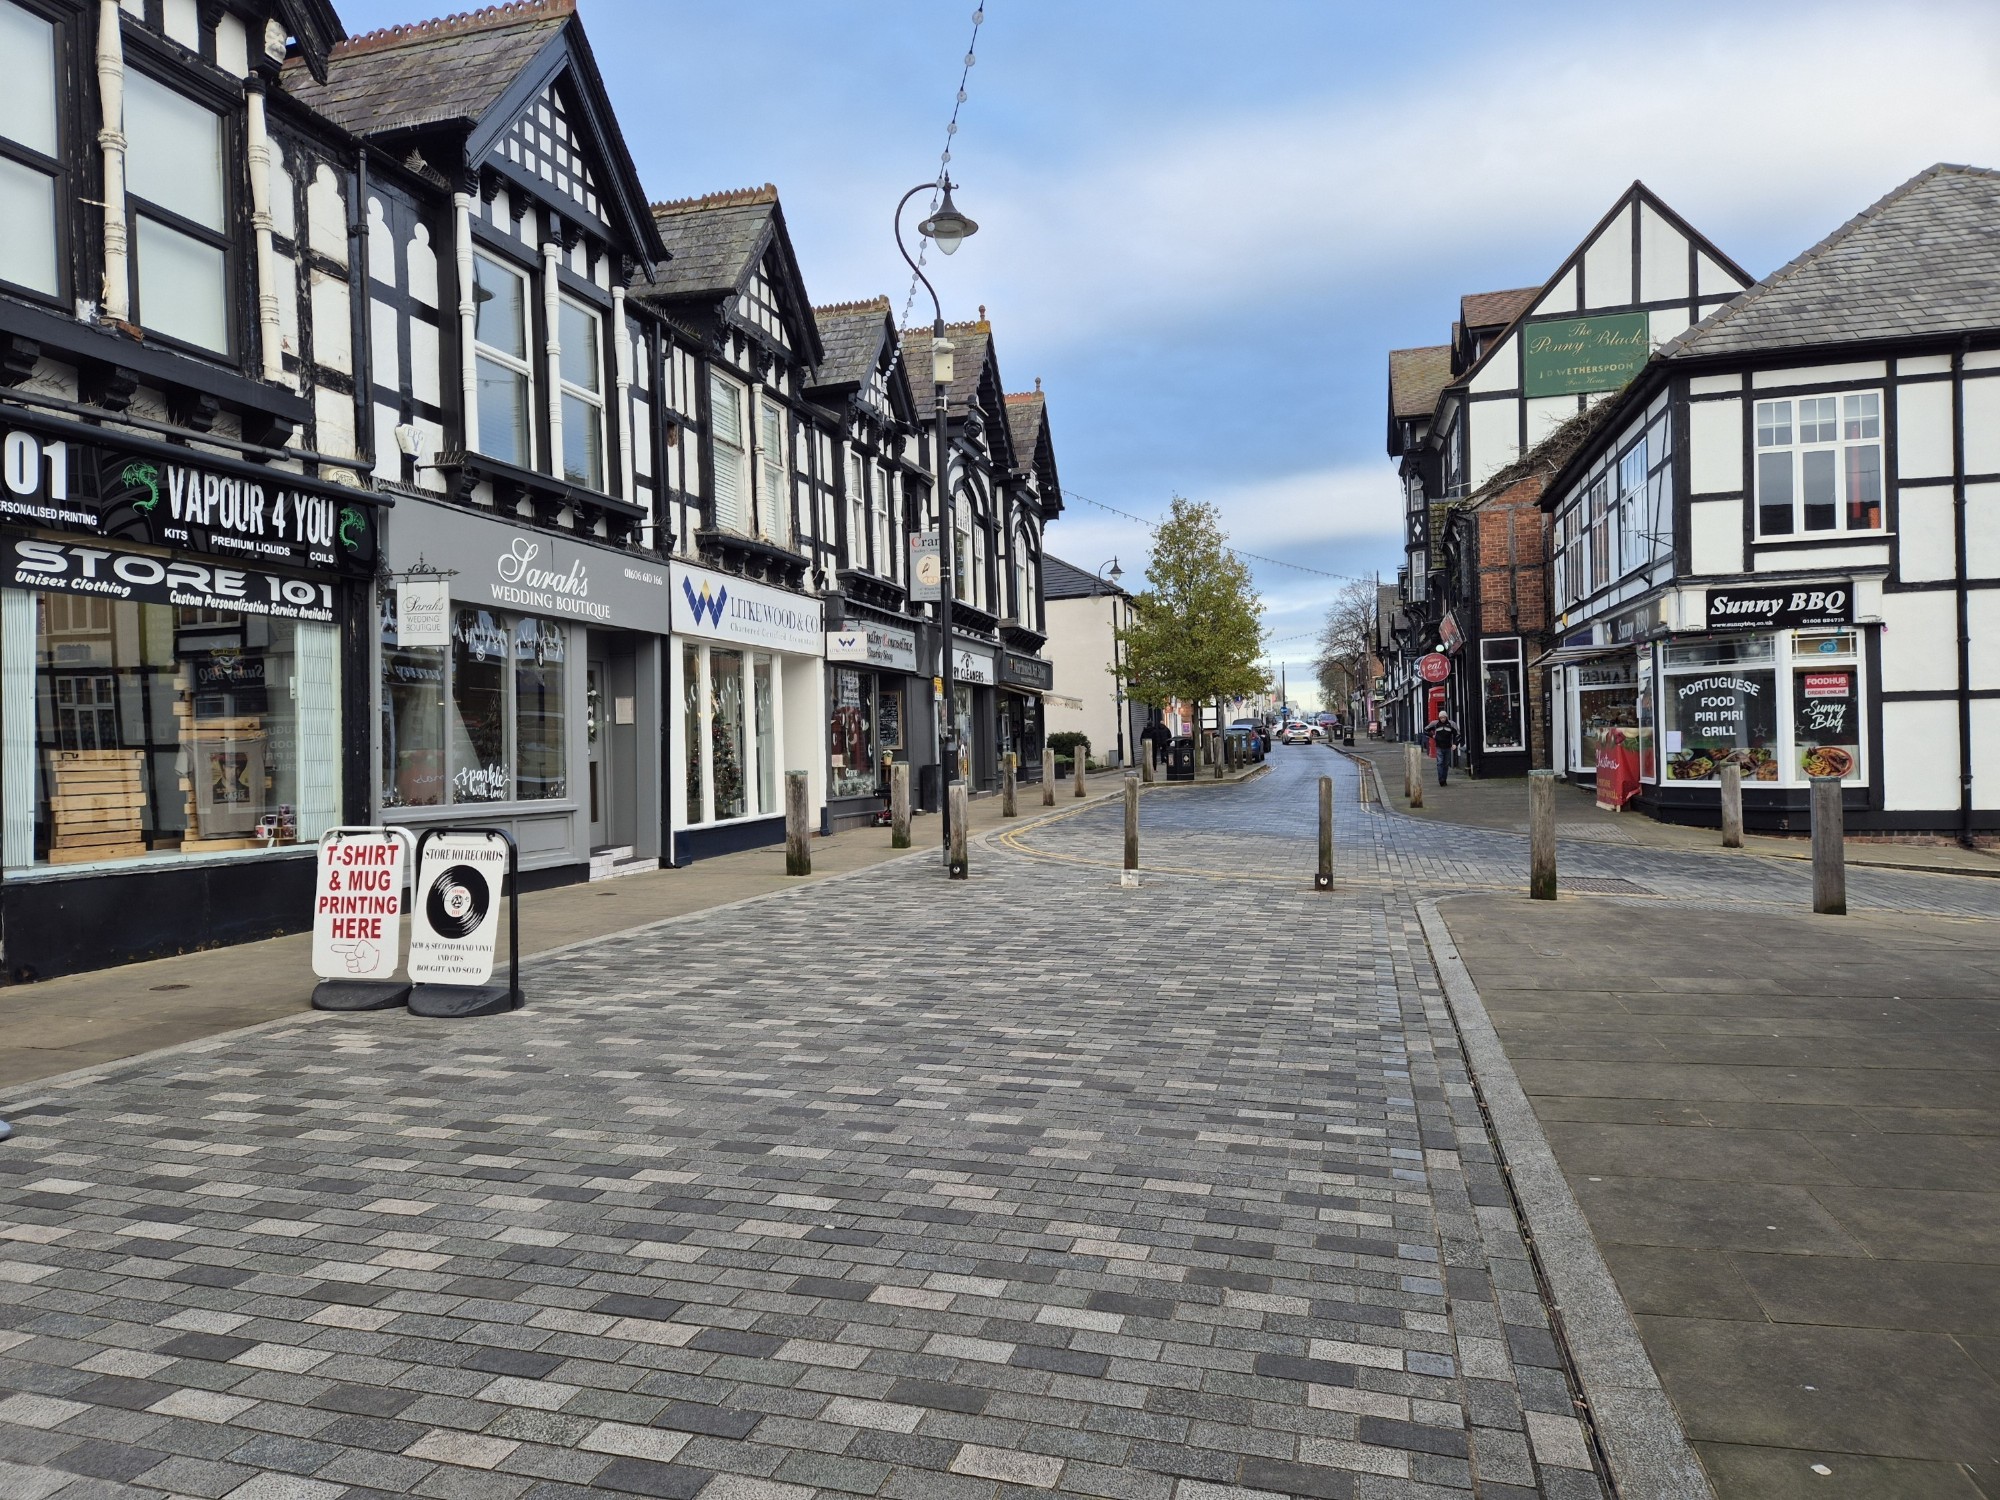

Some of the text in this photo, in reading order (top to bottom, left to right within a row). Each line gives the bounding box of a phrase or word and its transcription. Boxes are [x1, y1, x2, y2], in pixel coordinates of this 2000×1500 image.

[1568, 322, 1592, 337] The
[1530, 328, 1643, 356] Penny Black
[1556, 362, 1634, 376] WETHERSPOON
[0, 502, 98, 526] RSONALISED PRINTING
[167, 465, 334, 548] VAPOUR 4 YOU
[164, 528, 188, 541] KITS
[912, 536, 940, 548] Cran
[211, 535, 290, 556] PREMIUM LIQUIDS
[310, 551, 334, 564] COILS
[14, 540, 333, 608] STORE 101
[498, 537, 588, 598] Sarah's
[14, 570, 131, 598] Unisex Clothing
[169, 590, 333, 622] Custom Personalization Service Available
[402, 594, 444, 612] Sarah's
[490, 584, 611, 620] WEDDING BOUTIQUE
[1710, 590, 1846, 617] Sunny BBQ
[406, 615, 440, 623] WEDDING
[406, 624, 440, 632] BOUTIQUE
[805, 614, 819, 634] CO
[1618, 608, 1650, 641] Sunny BBQ
[961, 668, 984, 683] CLEANERS
[1806, 676, 1846, 685] FOODHUB
[1678, 676, 1760, 699] PORTUGUESE
[1701, 696, 1736, 707] FOOD
[1802, 700, 1847, 718] Sunny
[1694, 710, 1743, 722] PIRI PIRI
[1810, 713, 1843, 733] Bbq
[1702, 726, 1736, 736] GRILL
[453, 763, 510, 792] sparkle
[488, 786, 507, 799] love
[326, 844, 399, 866] T-SHIRT
[425, 848, 451, 860] STORE
[464, 850, 504, 862] RECORDS
[329, 870, 391, 891] & MUG
[318, 896, 397, 914] PRINTING
[332, 918, 382, 939] HERE
[412, 941, 424, 949] NEW
[475, 944, 494, 952] VINYL
[416, 964, 482, 974] BOUGHT AND SOLD
